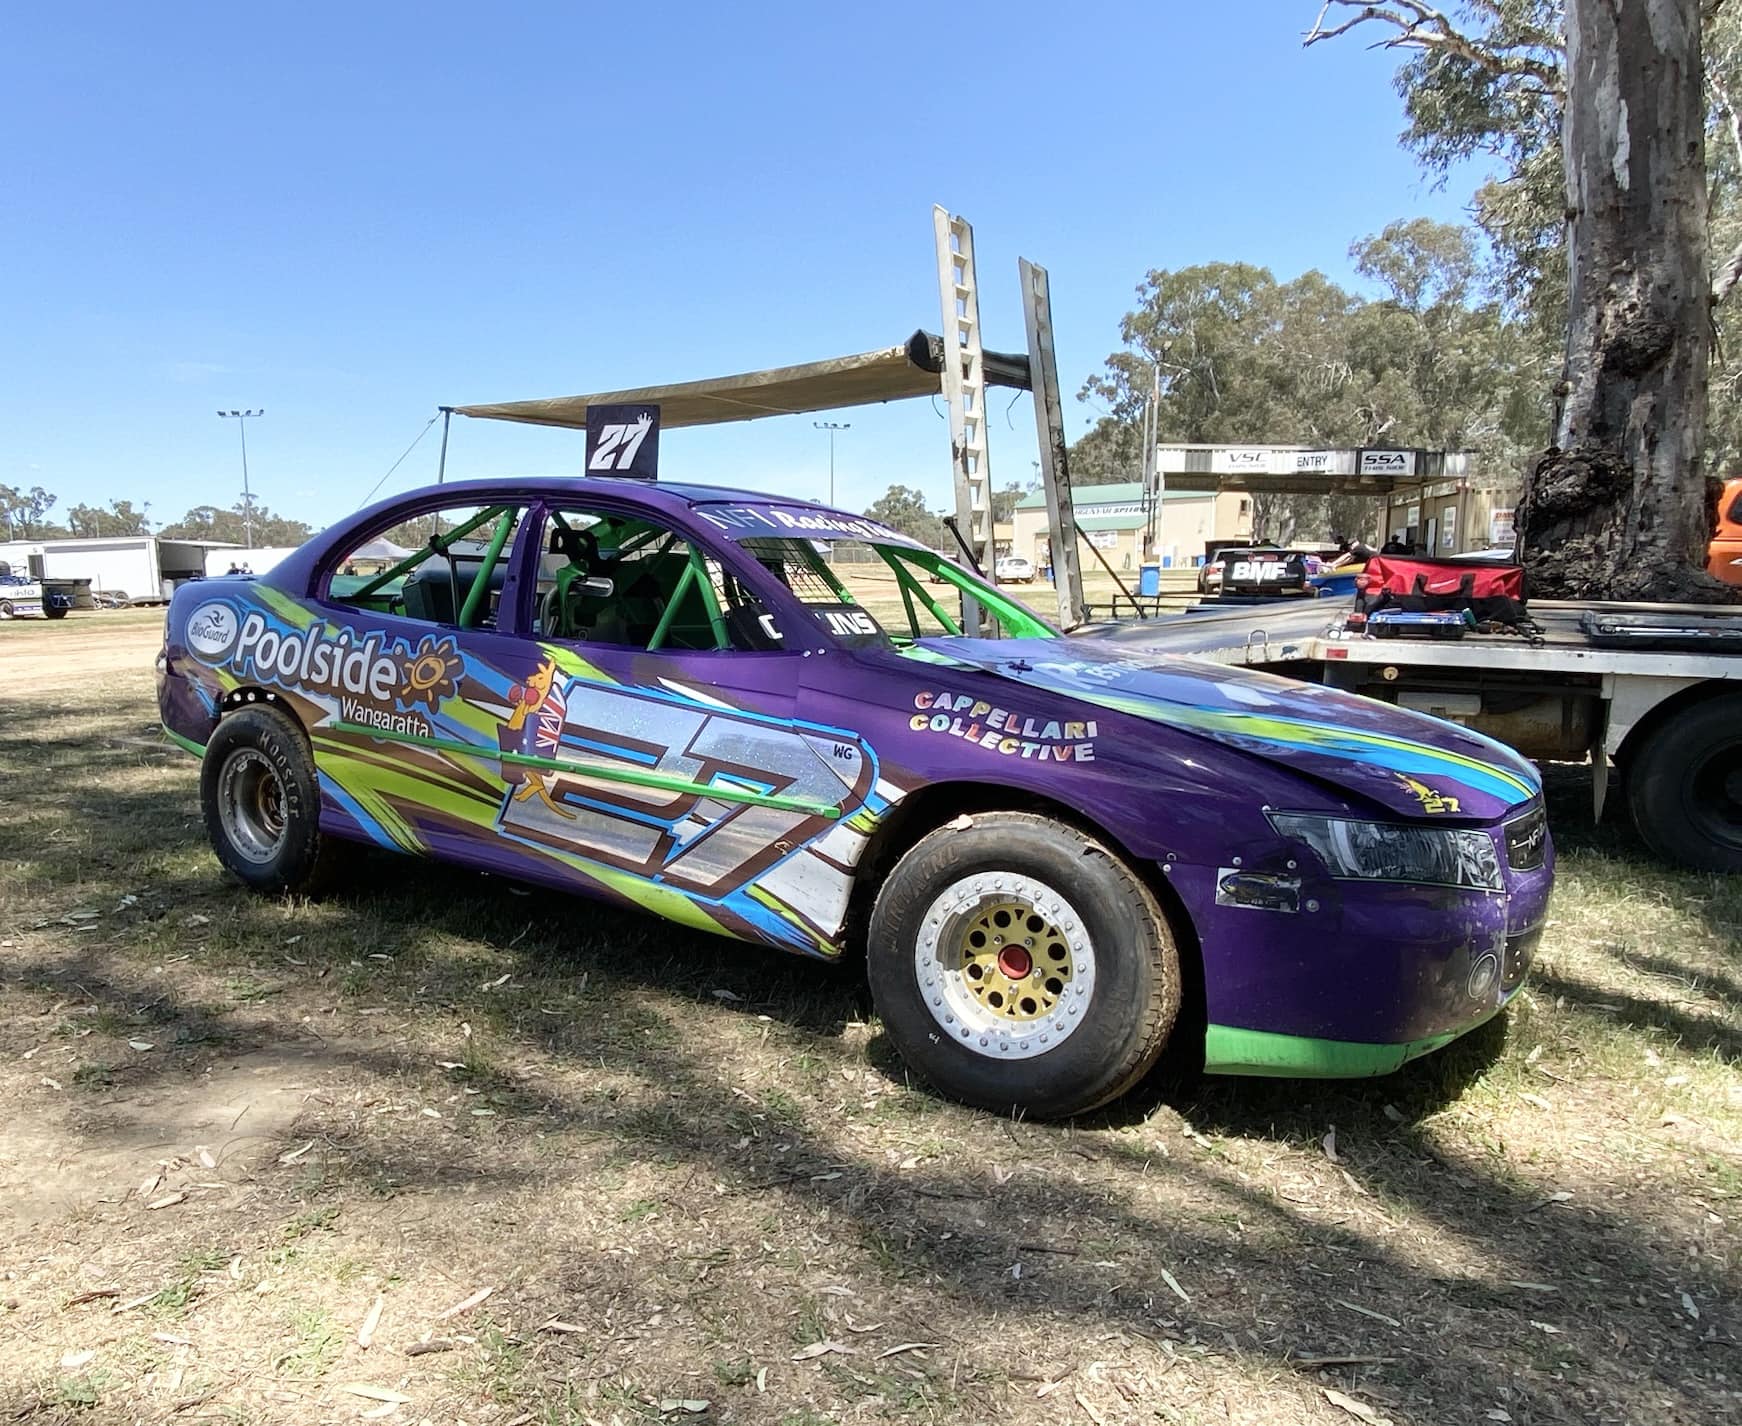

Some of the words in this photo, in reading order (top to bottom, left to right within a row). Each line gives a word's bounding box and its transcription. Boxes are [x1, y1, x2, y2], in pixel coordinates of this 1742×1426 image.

[588, 412, 654, 470] 27
[1297, 455, 1328, 467] ENTRY
[1364, 454, 1406, 464] SSA
[769, 510, 873, 539] Racing
[1231, 561, 1288, 586] BMF
[191, 621, 230, 643] BioGuard
[235, 613, 397, 701] Poolside
[342, 695, 429, 738] Wangaratta
[914, 691, 1098, 740] CAPPELLARI
[833, 743, 853, 760] WG
[909, 713, 1096, 763] COLLECTIVE
